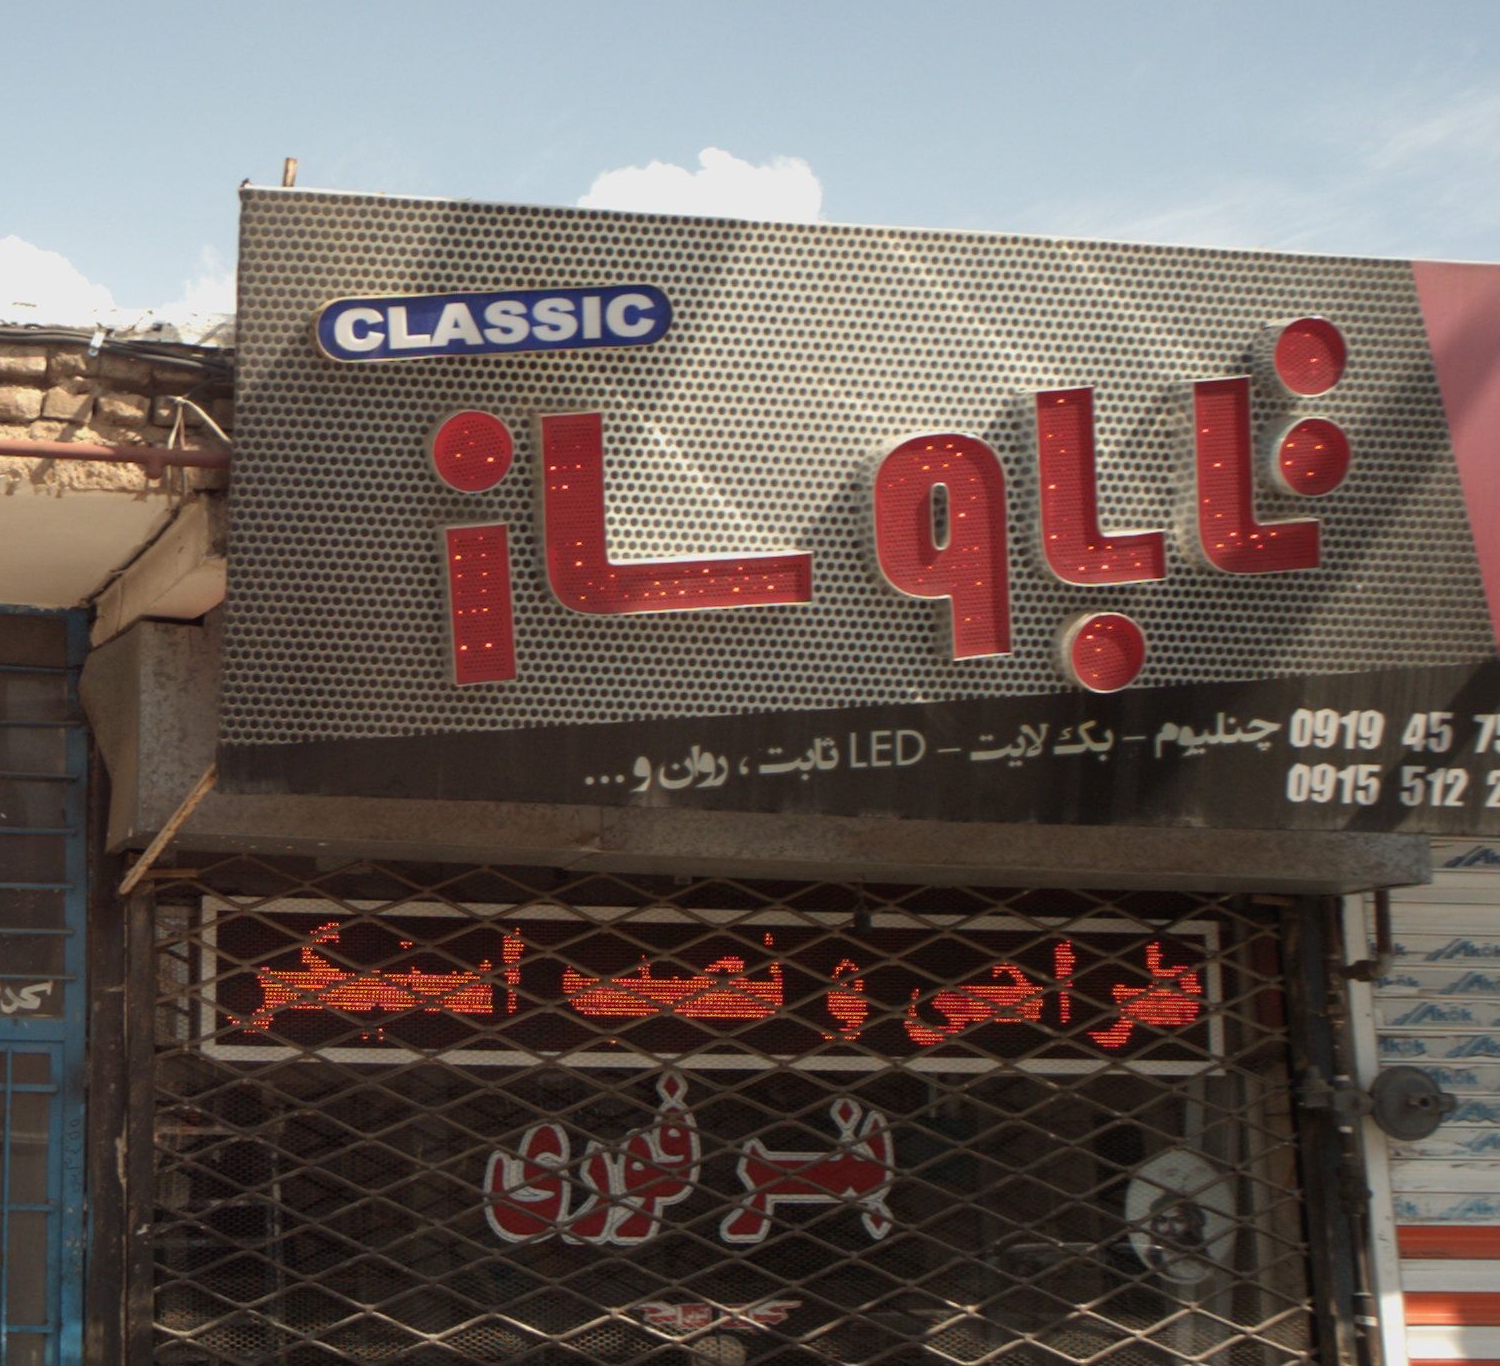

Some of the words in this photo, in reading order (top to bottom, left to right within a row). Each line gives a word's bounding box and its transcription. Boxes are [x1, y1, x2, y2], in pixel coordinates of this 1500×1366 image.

[334, 292, 656, 352] CLASSIC
[849, 729, 926, 768] LED
[1154, 711, 1282, 758] چنلیوم
[1289, 708, 1385, 750] 0919
[1402, 711, 1455, 753] 45
[1473, 713, 1500, 753] 7
[657, 744, 729, 792] روان
[1286, 763, 1381, 806] 0915
[1400, 766, 1468, 807] 512
[484, 1071, 700, 1245] فوری
[720, 1098, 895, 1242] بنر
